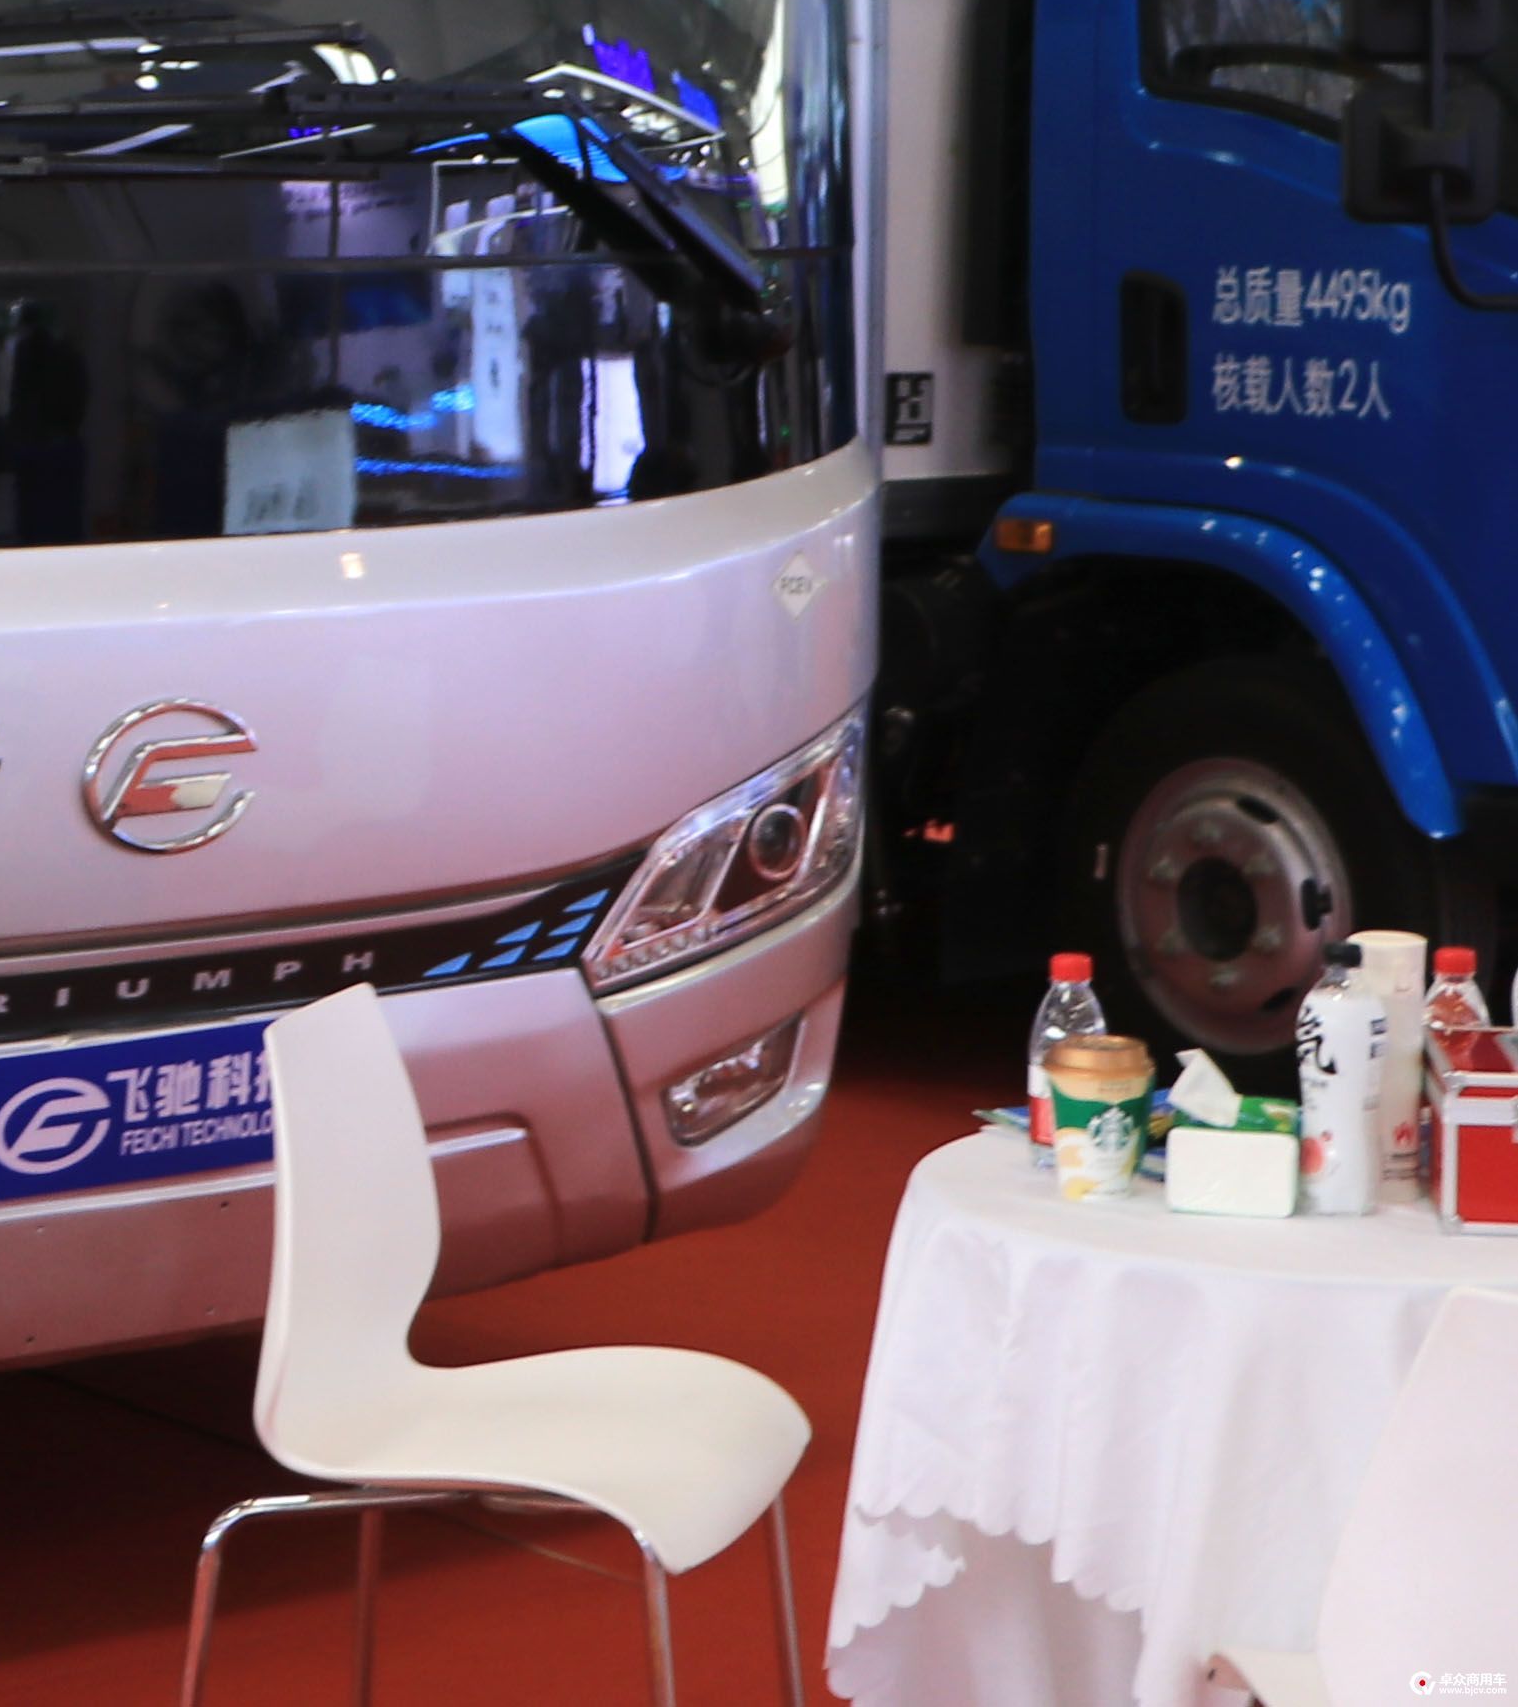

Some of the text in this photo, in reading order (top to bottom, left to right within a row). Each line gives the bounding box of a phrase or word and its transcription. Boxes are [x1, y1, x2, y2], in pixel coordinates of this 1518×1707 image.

[1213, 266, 1411, 334] 总质量4495kg
[1212, 354, 1391, 419] 核载人数2人
[120, 1123, 181, 1156] FEICHI
